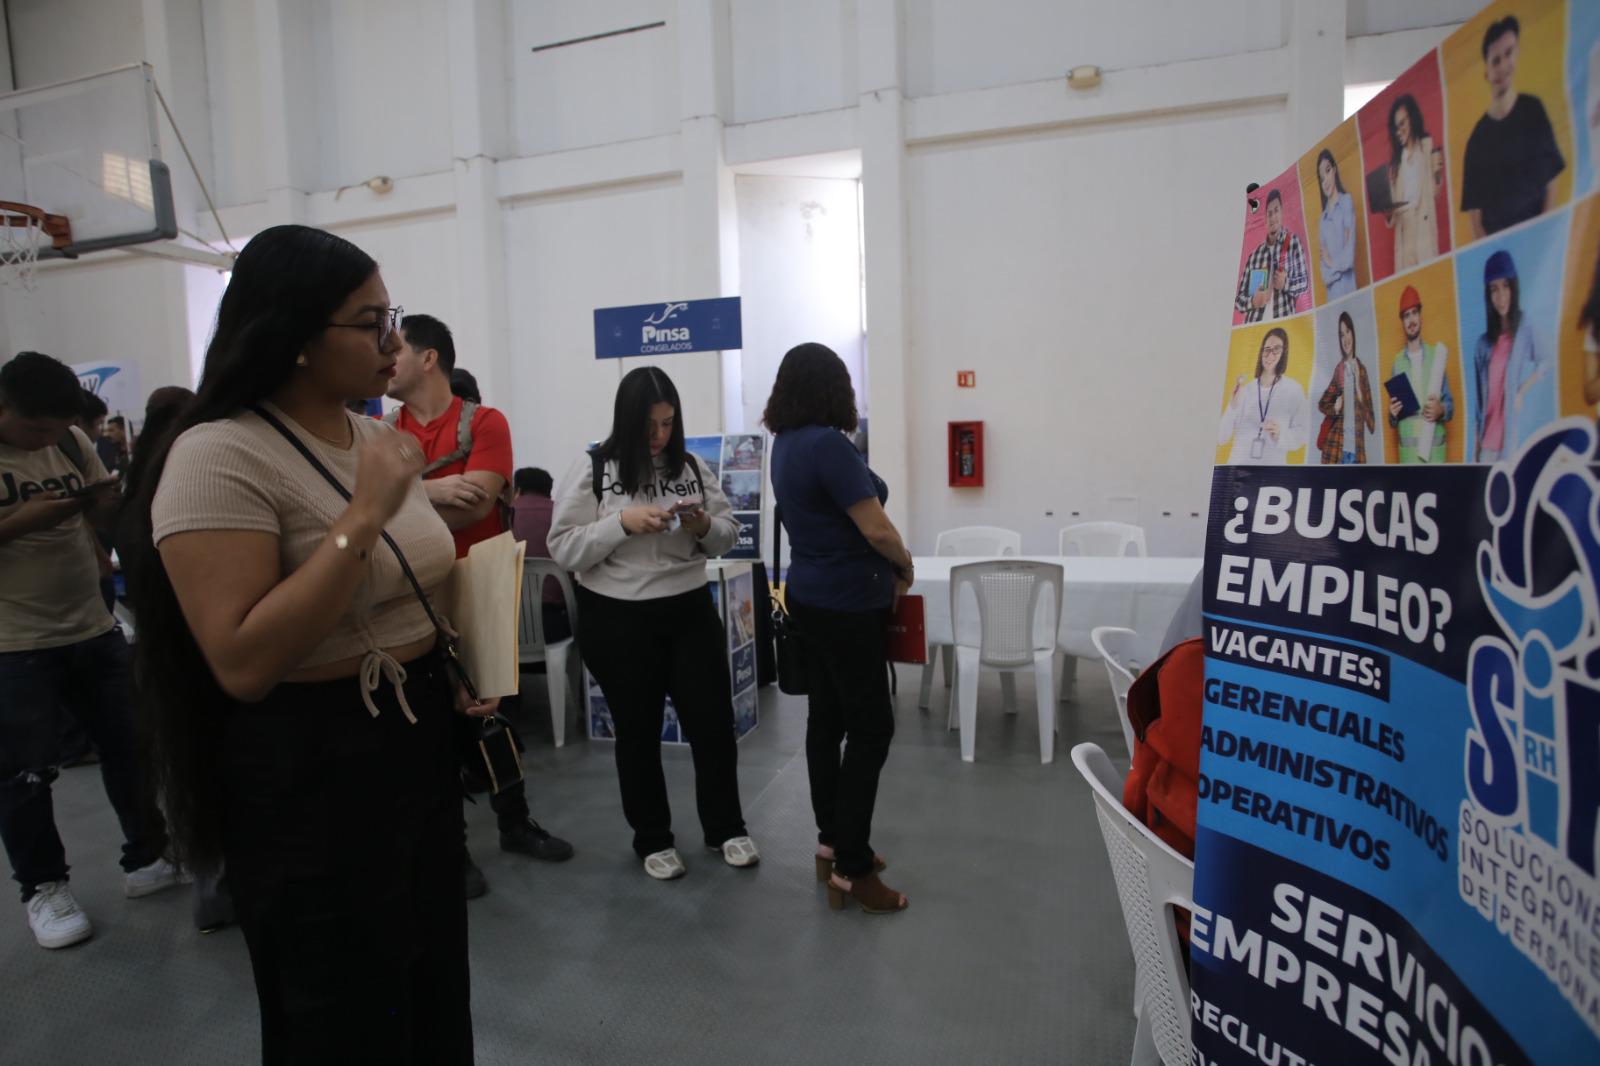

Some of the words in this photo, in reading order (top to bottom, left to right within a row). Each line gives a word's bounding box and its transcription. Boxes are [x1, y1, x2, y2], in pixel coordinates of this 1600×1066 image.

[640, 342, 693, 353] CONGELADOS
[642, 325, 690, 343] Pinsa
[1223, 485, 1440, 555] ¿BUSCAS
[1216, 553, 1453, 653] EMPLEO?
[1210, 625, 1382, 690] VACANTES:
[1204, 677, 1406, 763] GERENCIALES
[1524, 734, 1557, 778] RH
[1198, 773, 1391, 871] OPERATIVOS
[1199, 725, 1449, 863] ADMINISTRATIVOS
[1462, 874, 1489, 910] DE
